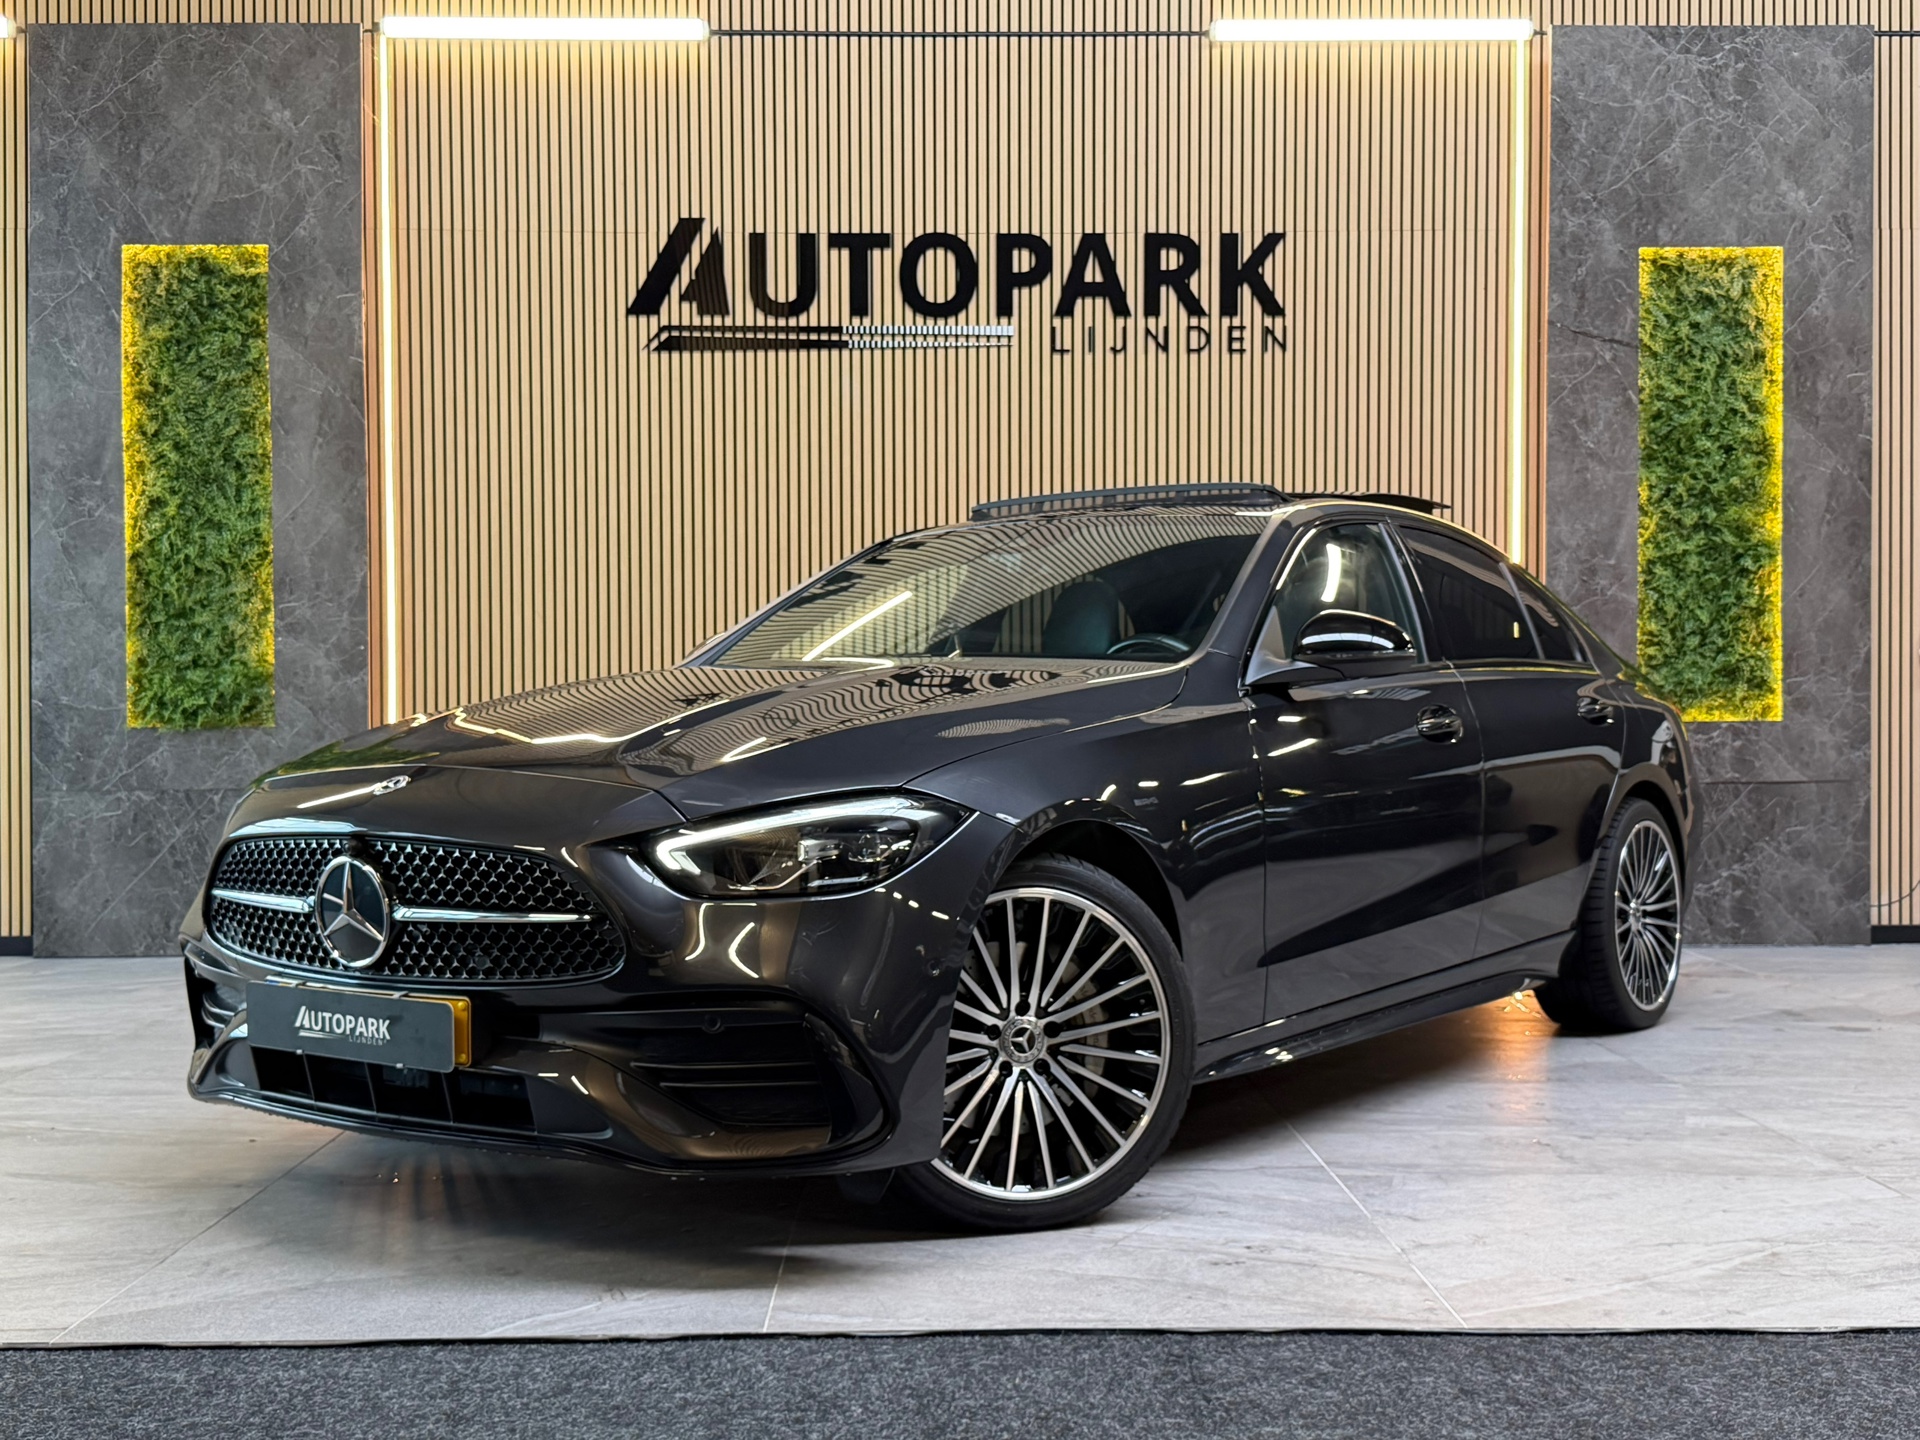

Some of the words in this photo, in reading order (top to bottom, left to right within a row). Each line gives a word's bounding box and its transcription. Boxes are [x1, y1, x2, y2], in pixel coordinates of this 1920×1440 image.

[627, 217, 1287, 317] AUTOPARK
[1051, 325, 1287, 354] LIJNDEN
[294, 1005, 391, 1040] AUTOPARK
